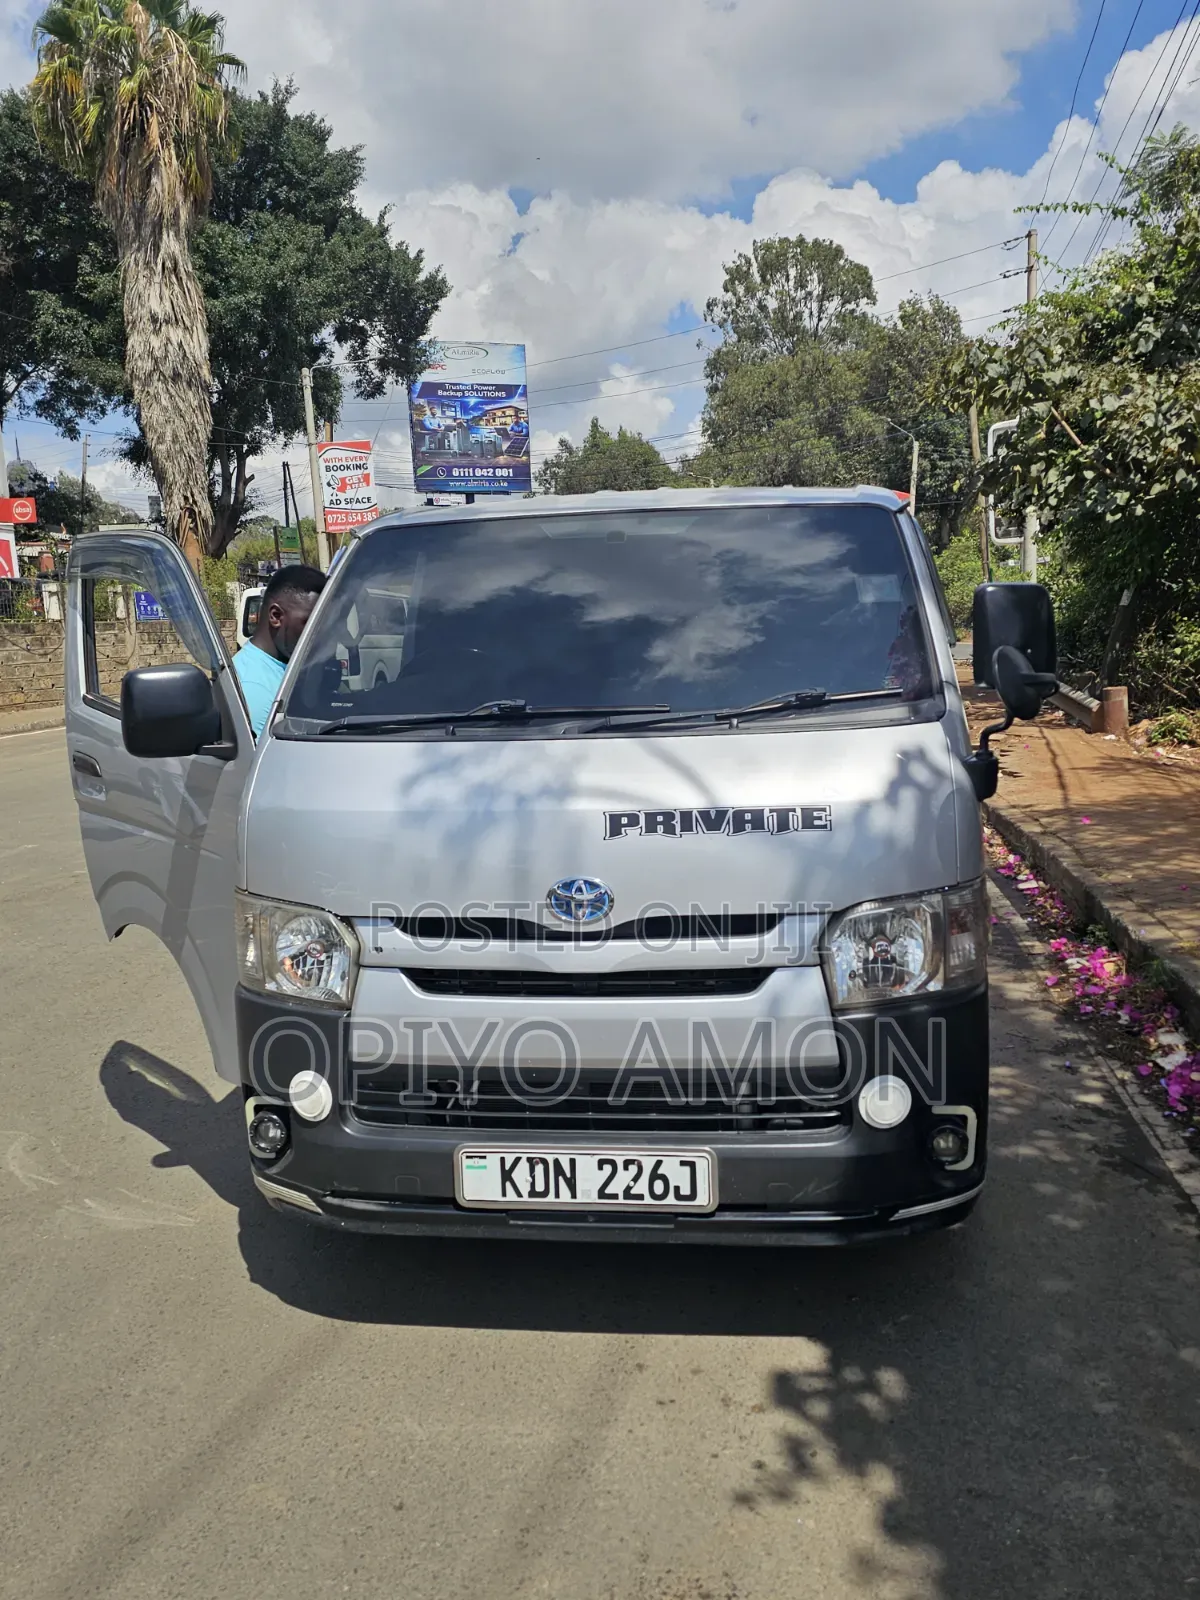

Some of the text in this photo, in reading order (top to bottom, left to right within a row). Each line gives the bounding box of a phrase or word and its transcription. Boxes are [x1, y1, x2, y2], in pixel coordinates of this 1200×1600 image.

[444, 383, 472, 391] Trusted
[437, 389, 506, 398] Backup SOLUTIONS
[325, 463, 368, 472] BOOKING
[452, 467, 513, 477] 0111 042 001
[346, 474, 364, 484] GET
[329, 497, 372, 506] AD SPACE
[15, 506, 30, 514] absa
[327, 511, 377, 523] 0725 654 385
[603, 804, 832, 841] PRIVATE
[500, 1156, 577, 1199] KDN
[597, 1158, 698, 1202] 226J
